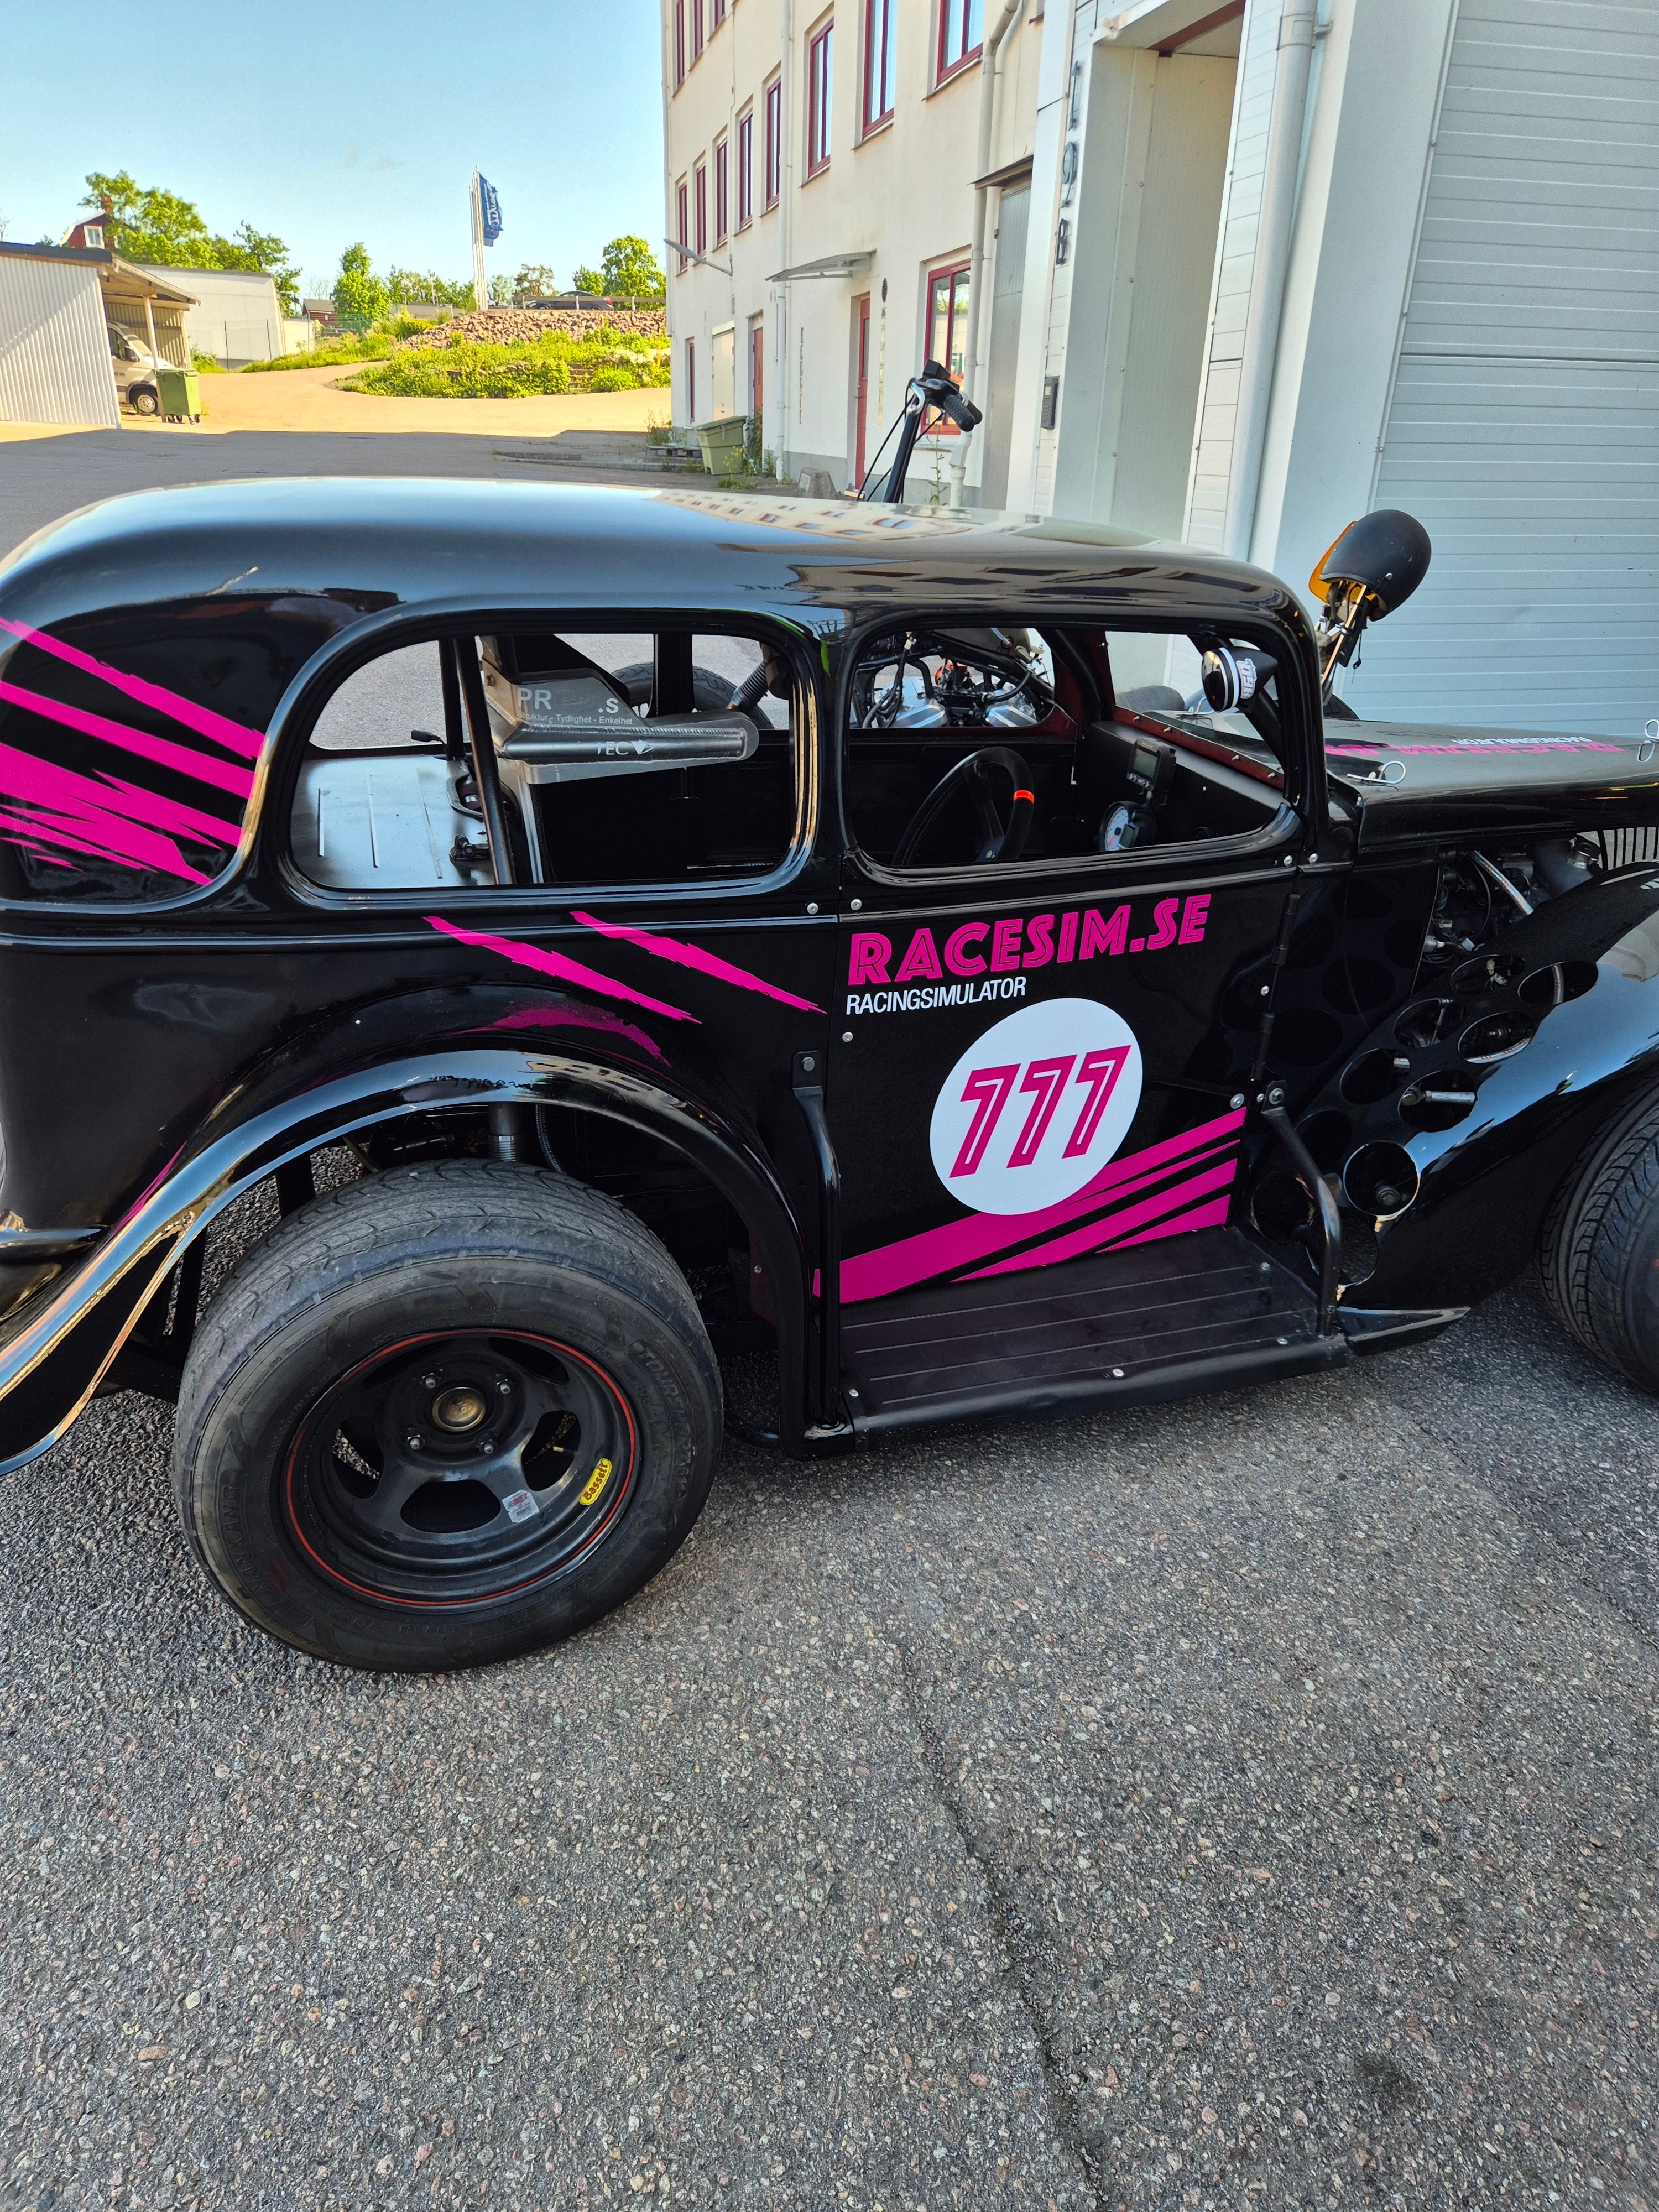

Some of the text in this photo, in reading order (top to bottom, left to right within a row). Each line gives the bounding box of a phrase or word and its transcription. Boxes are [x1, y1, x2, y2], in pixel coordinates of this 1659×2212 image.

[518, 711, 548, 721] Struktur
[555, 714, 592, 724] Tydlighet
[599, 716, 633, 725] Enkelhet
[848, 894, 1211, 986] RACESIM.SE
[846, 977, 1026, 1015] RACINGSIMULATOR
[949, 1045, 1131, 1178] 777
[222, 1483, 273, 1597] NANKANG
